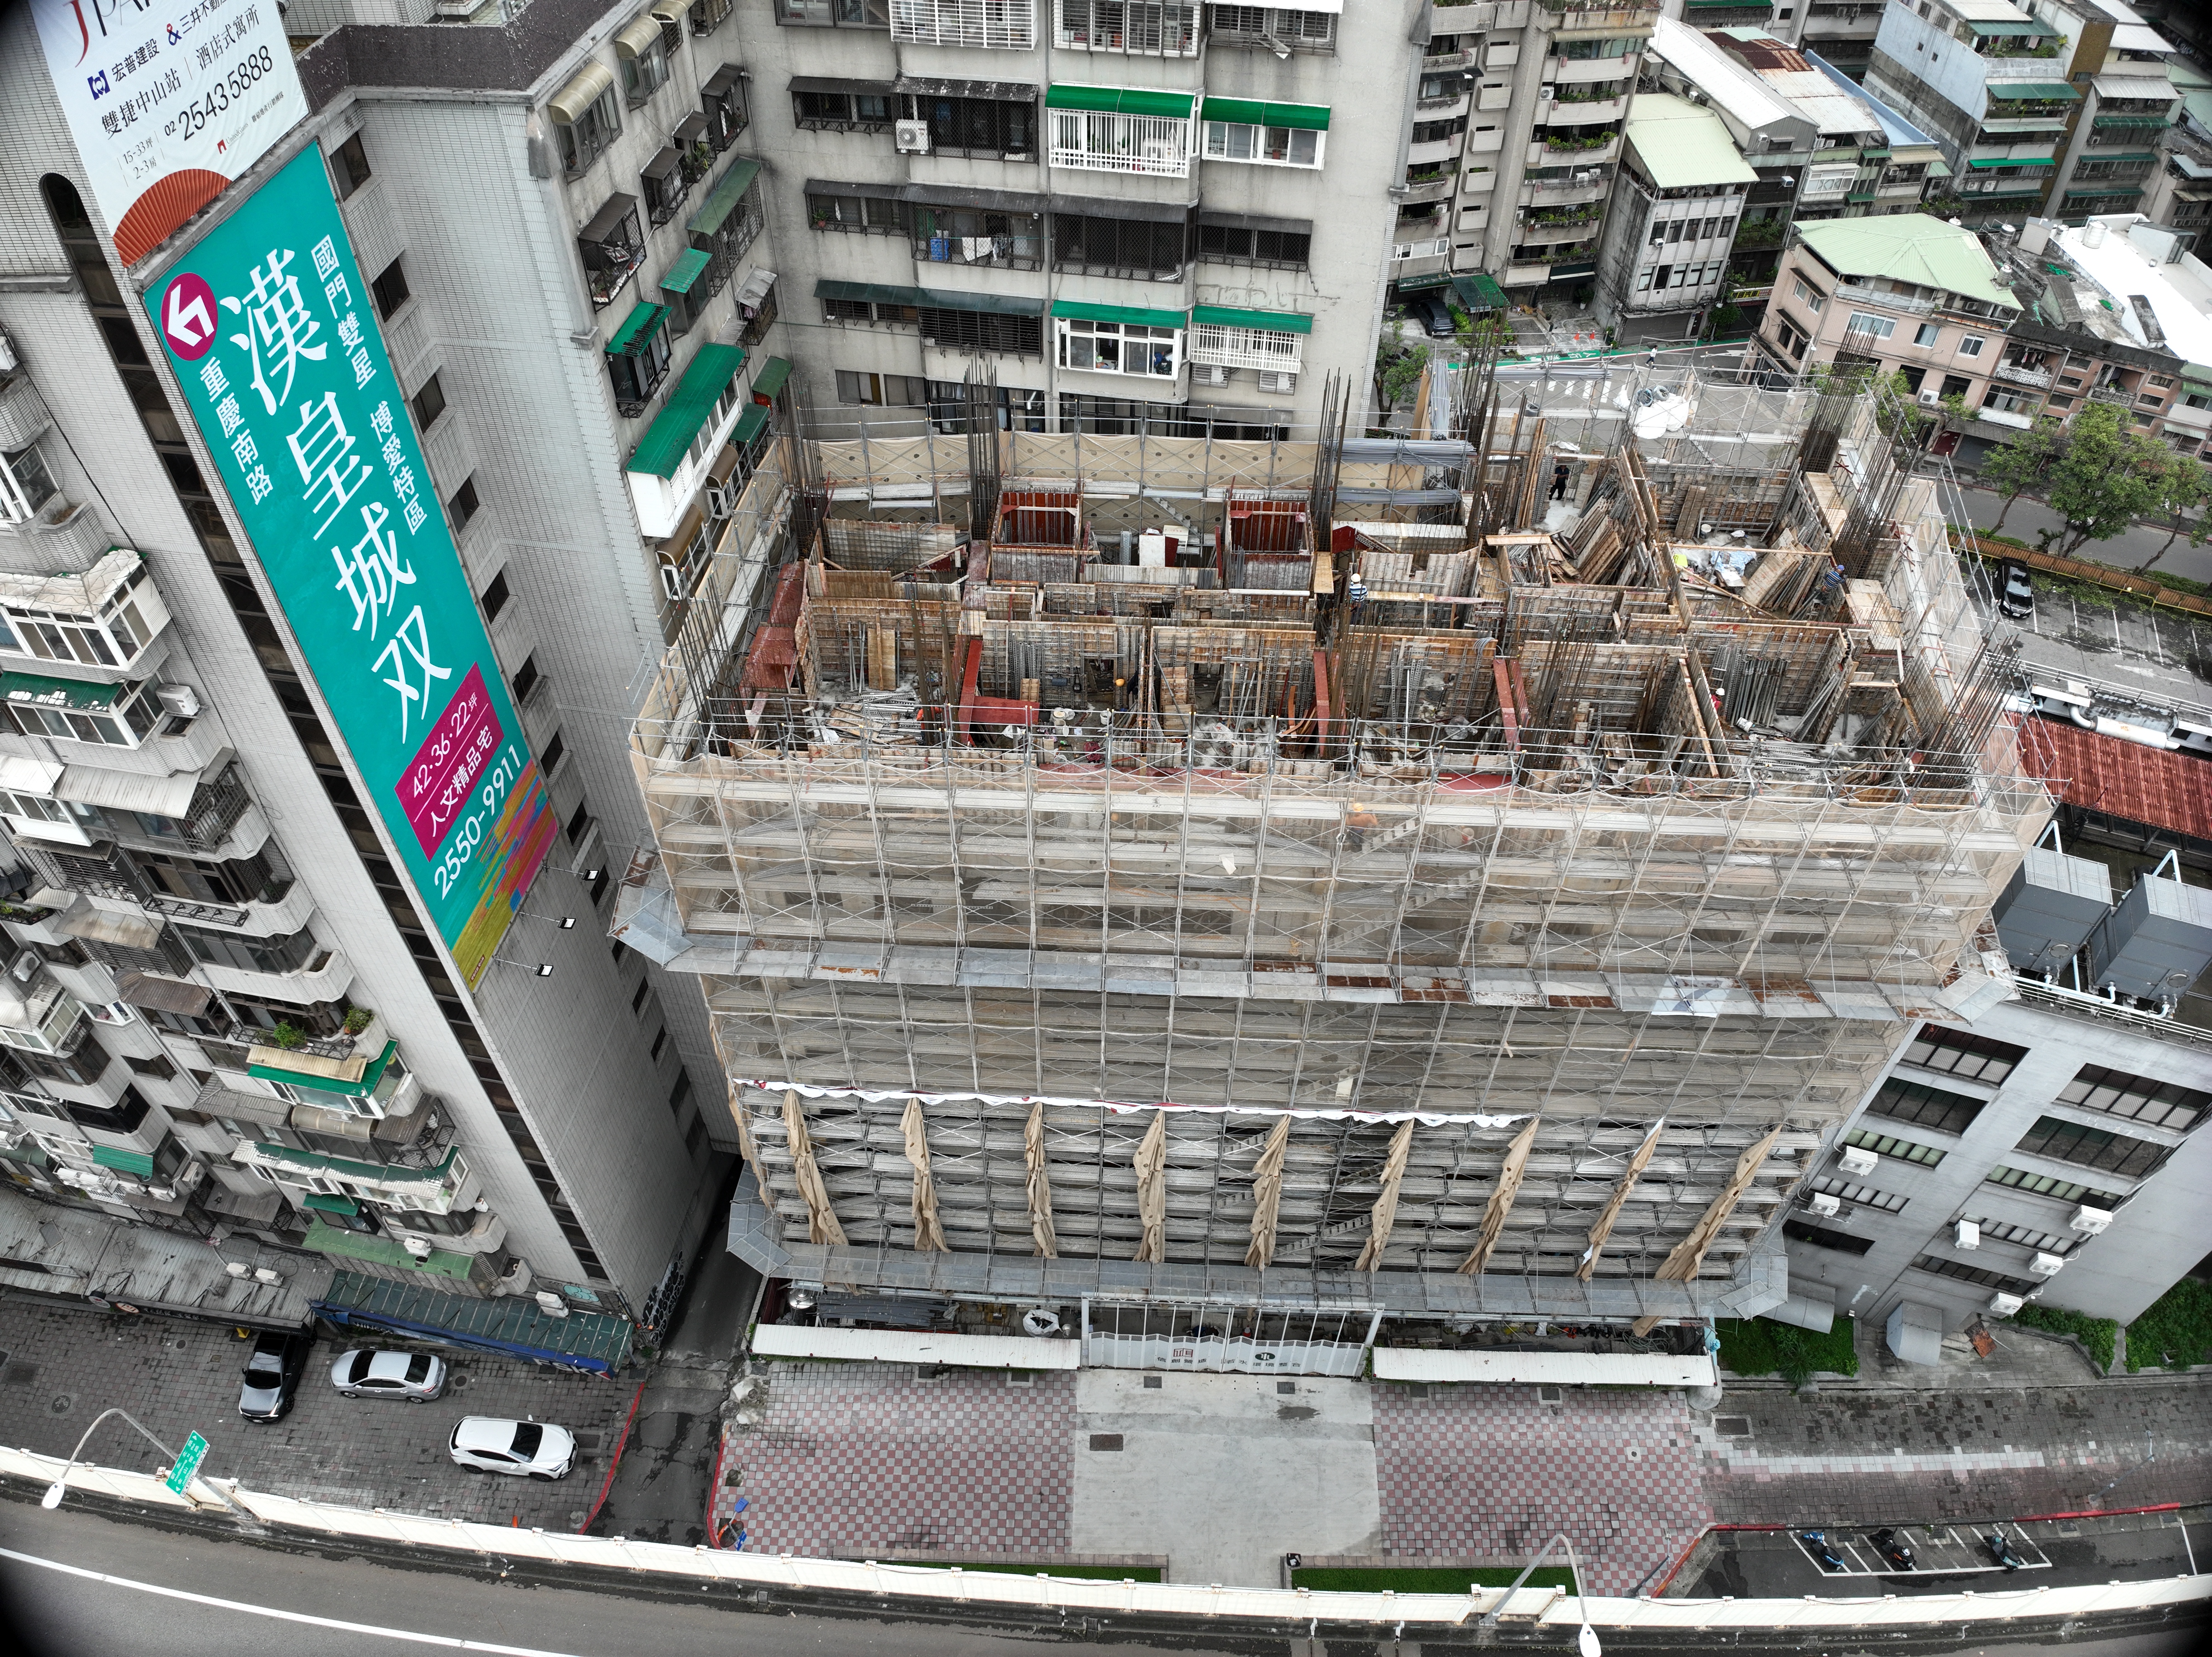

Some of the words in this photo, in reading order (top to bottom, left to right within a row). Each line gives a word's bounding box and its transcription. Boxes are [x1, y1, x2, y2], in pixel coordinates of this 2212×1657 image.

[102, 68, 181, 140] 雙捷中山站
[196, 4, 259, 70] 酒店式寓所
[111, 38, 160, 82] 宏普建設
[179, 0, 227, 34] 三井不動
[123, 137, 152, 164] 15-33坪
[133, 156, 156, 180] 2-3房
[164, 121, 176, 136] 02
[199, 356, 273, 506] 重慶南路
[311, 234, 377, 390] 國門雙星
[371, 400, 427, 536] 博愛特區
[220, 248, 452, 744] 漢皇城双
[430, 725, 494, 838] 人文精品宅
[434, 744, 521, 900] 2550-9911
[532, 1358, 594, 1376] FSK
